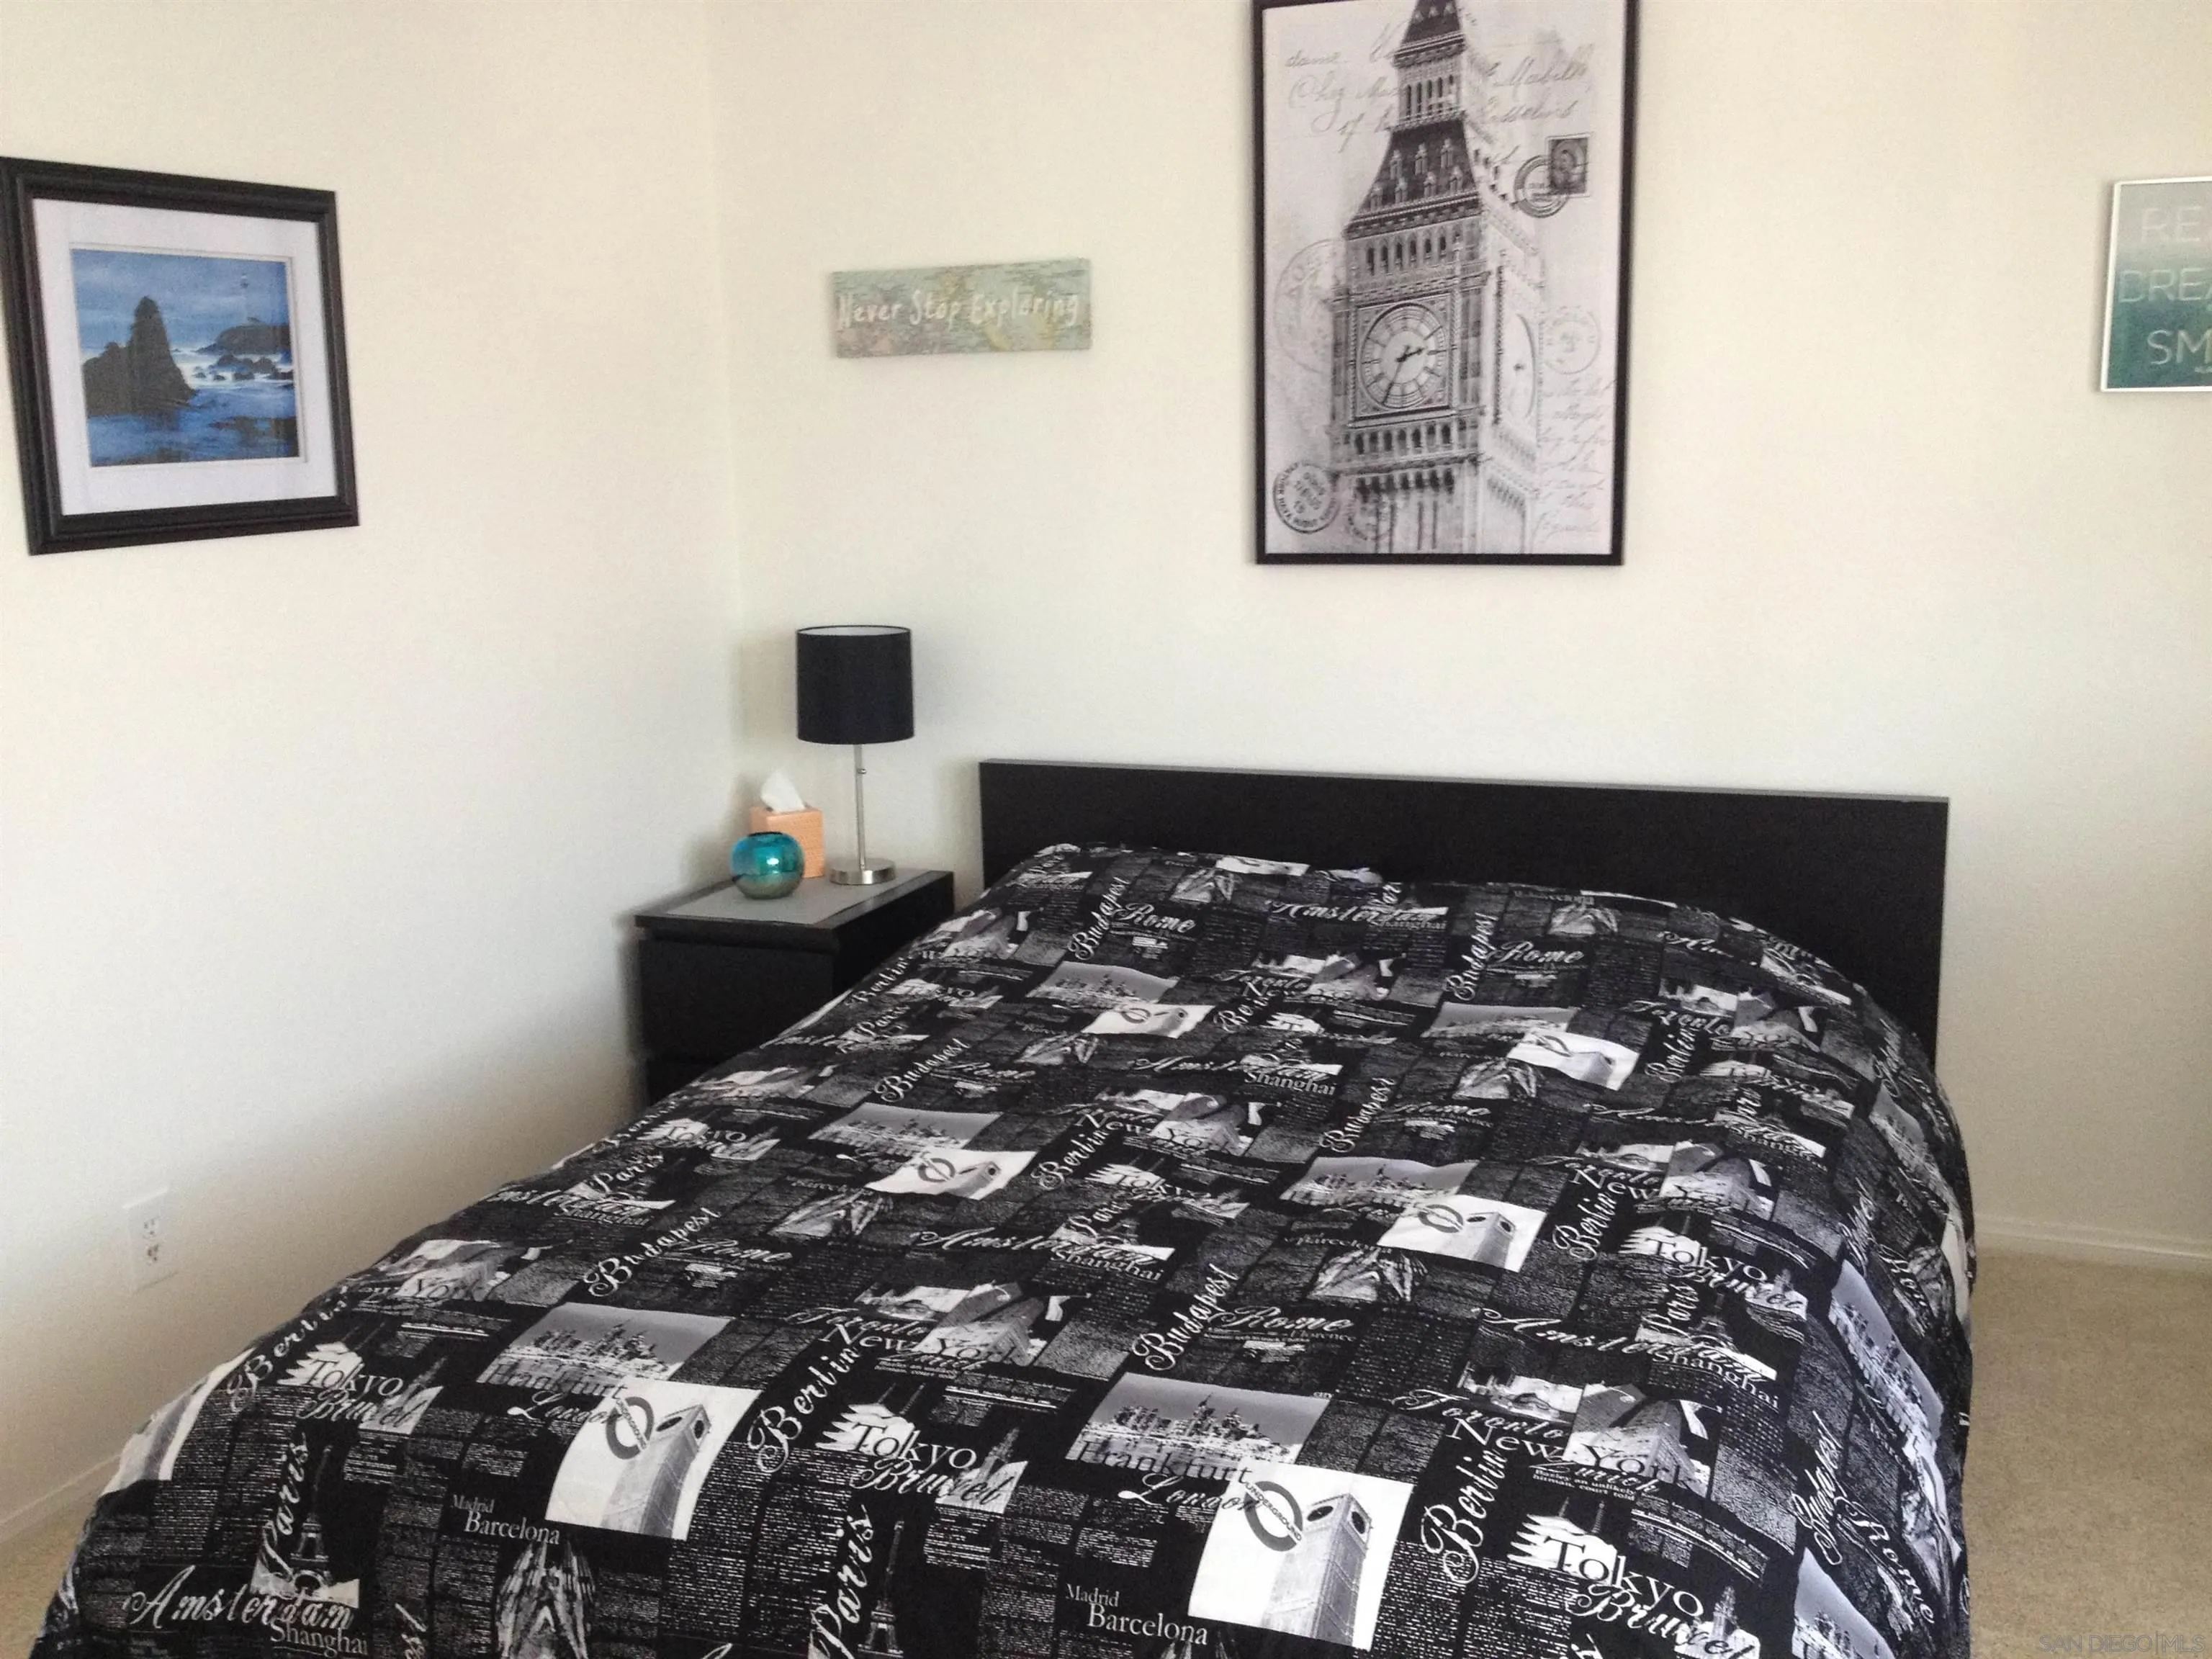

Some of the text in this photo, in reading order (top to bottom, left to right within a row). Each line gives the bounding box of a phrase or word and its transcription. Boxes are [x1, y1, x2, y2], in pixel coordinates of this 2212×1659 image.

[837, 287, 1079, 330] Never Stop Exploring
[1067, 876, 1130, 960] Budapest
[1115, 903, 1196, 933] Rome
[1442, 912, 1499, 1001] Budapest
[1485, 941, 1585, 968] Rome
[874, 1038, 971, 1102] Budapest
[1244, 1071, 1337, 1096] Shanghai
[1030, 1129, 1110, 1190] Berlin
[1552, 1192, 1619, 1261] Berlin
[583, 1207, 721, 1297] Budapest
[1051, 1249, 1164, 1281] Shanghai
[1645, 1238, 1768, 1282] Tokyo
[819, 1323, 922, 1352] New
[1131, 1263, 1240, 1370] Budapest
[1206, 1305, 1354, 1332] Rome
[226, 1298, 349, 1413] Berlin
[302, 1358, 404, 1400] Tokyo
[1652, 1352, 1780, 1408] Shanghai
[747, 1345, 861, 1473] Berlin
[1393, 1388, 1565, 1439] Toronto
[853, 1423, 978, 1474] Tokyo
[1082, 1439, 1253, 1486] Frankfurt
[1446, 1418, 1574, 1462] New
[453, 1493, 495, 1514] Madrid
[1118, 1473, 1260, 1511] London
[1244, 1483, 1302, 1542] UNDERGROUND
[1578, 1484, 1609, 1496] court
[1613, 1491, 1635, 1502] told
[464, 1510, 560, 1545] Barcelona
[1420, 1448, 1509, 1585] Berlin
[122, 1565, 356, 1631] Amsterdam
[810, 1503, 874, 1659] Paris
[1065, 1583, 1120, 1608] Madrid
[1543, 1534, 1704, 1617] Tokyo
[270, 1620, 368, 1657] Shanghai
[1087, 1602, 1208, 1647] Barcelona
